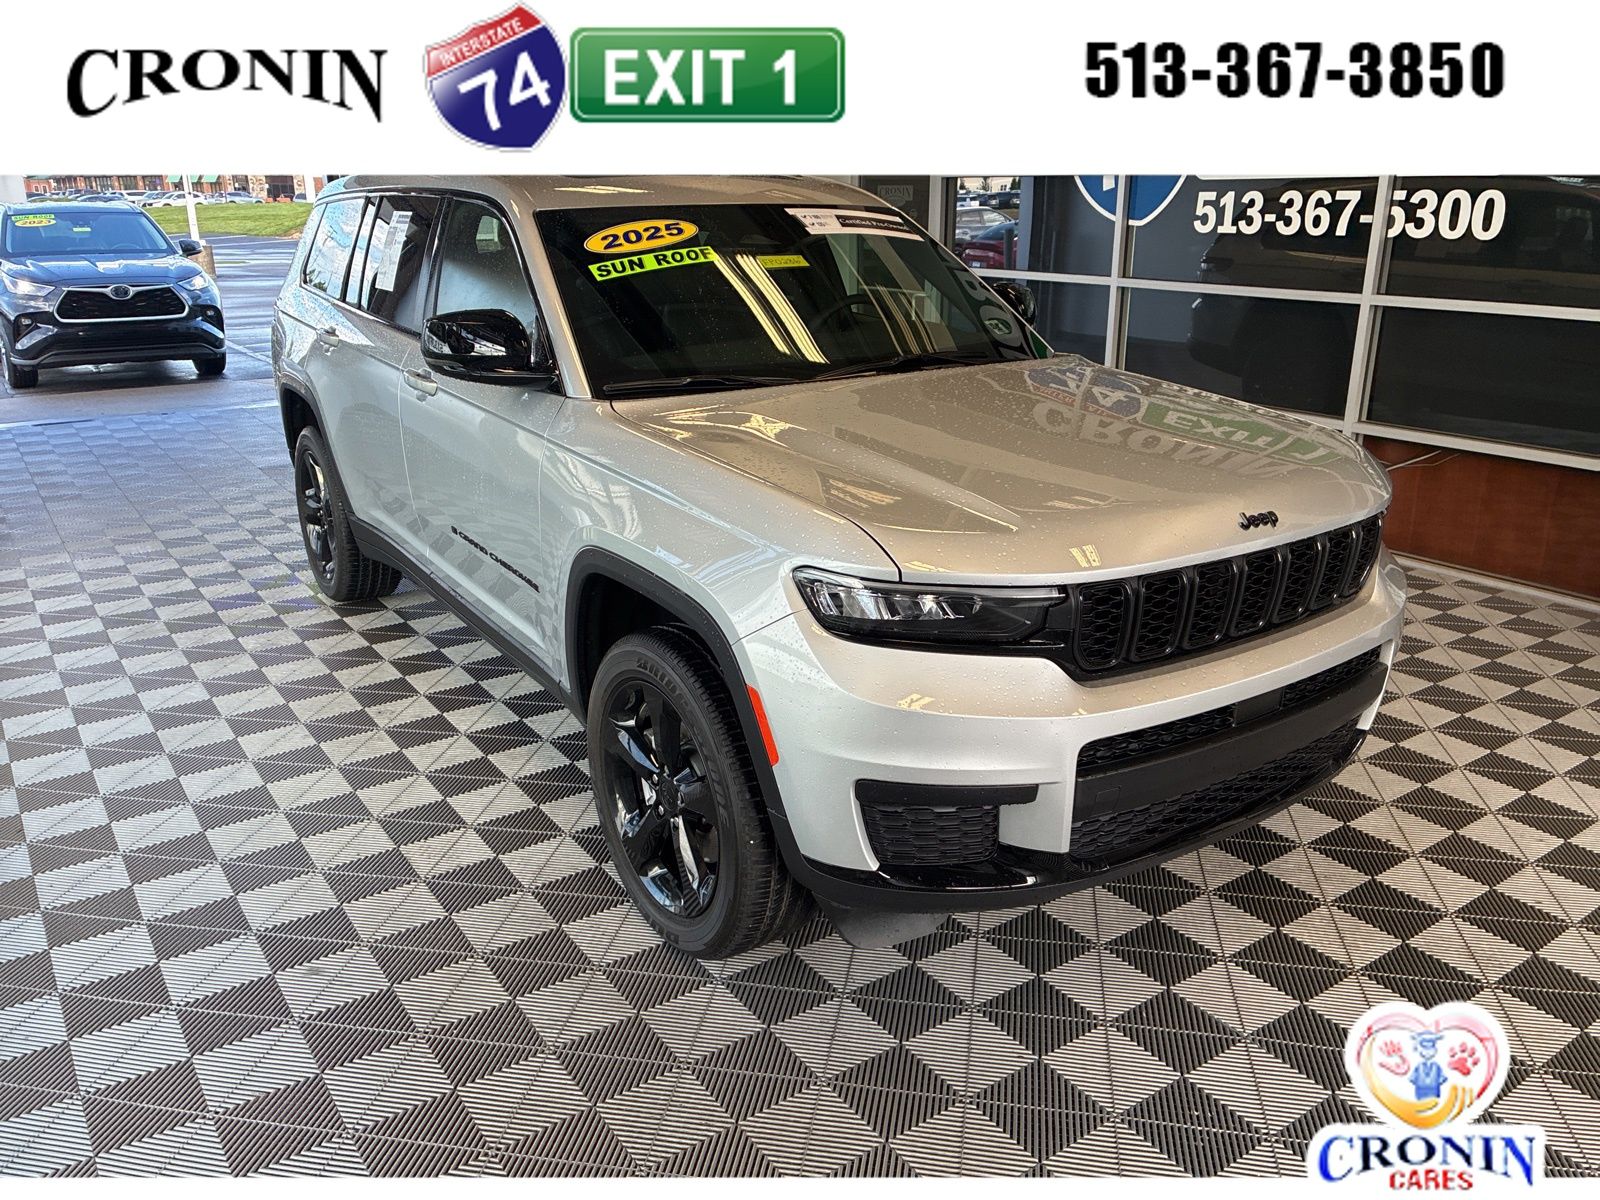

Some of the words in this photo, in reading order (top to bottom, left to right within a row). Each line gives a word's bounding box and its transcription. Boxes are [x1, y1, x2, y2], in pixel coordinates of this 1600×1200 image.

[1193, 188, 1507, 242] 513-367-5300
[600, 222, 686, 251] 2025
[596, 257, 646, 278] SUN
[652, 247, 714, 267] ROOF
[1238, 510, 1279, 531] Jeep
